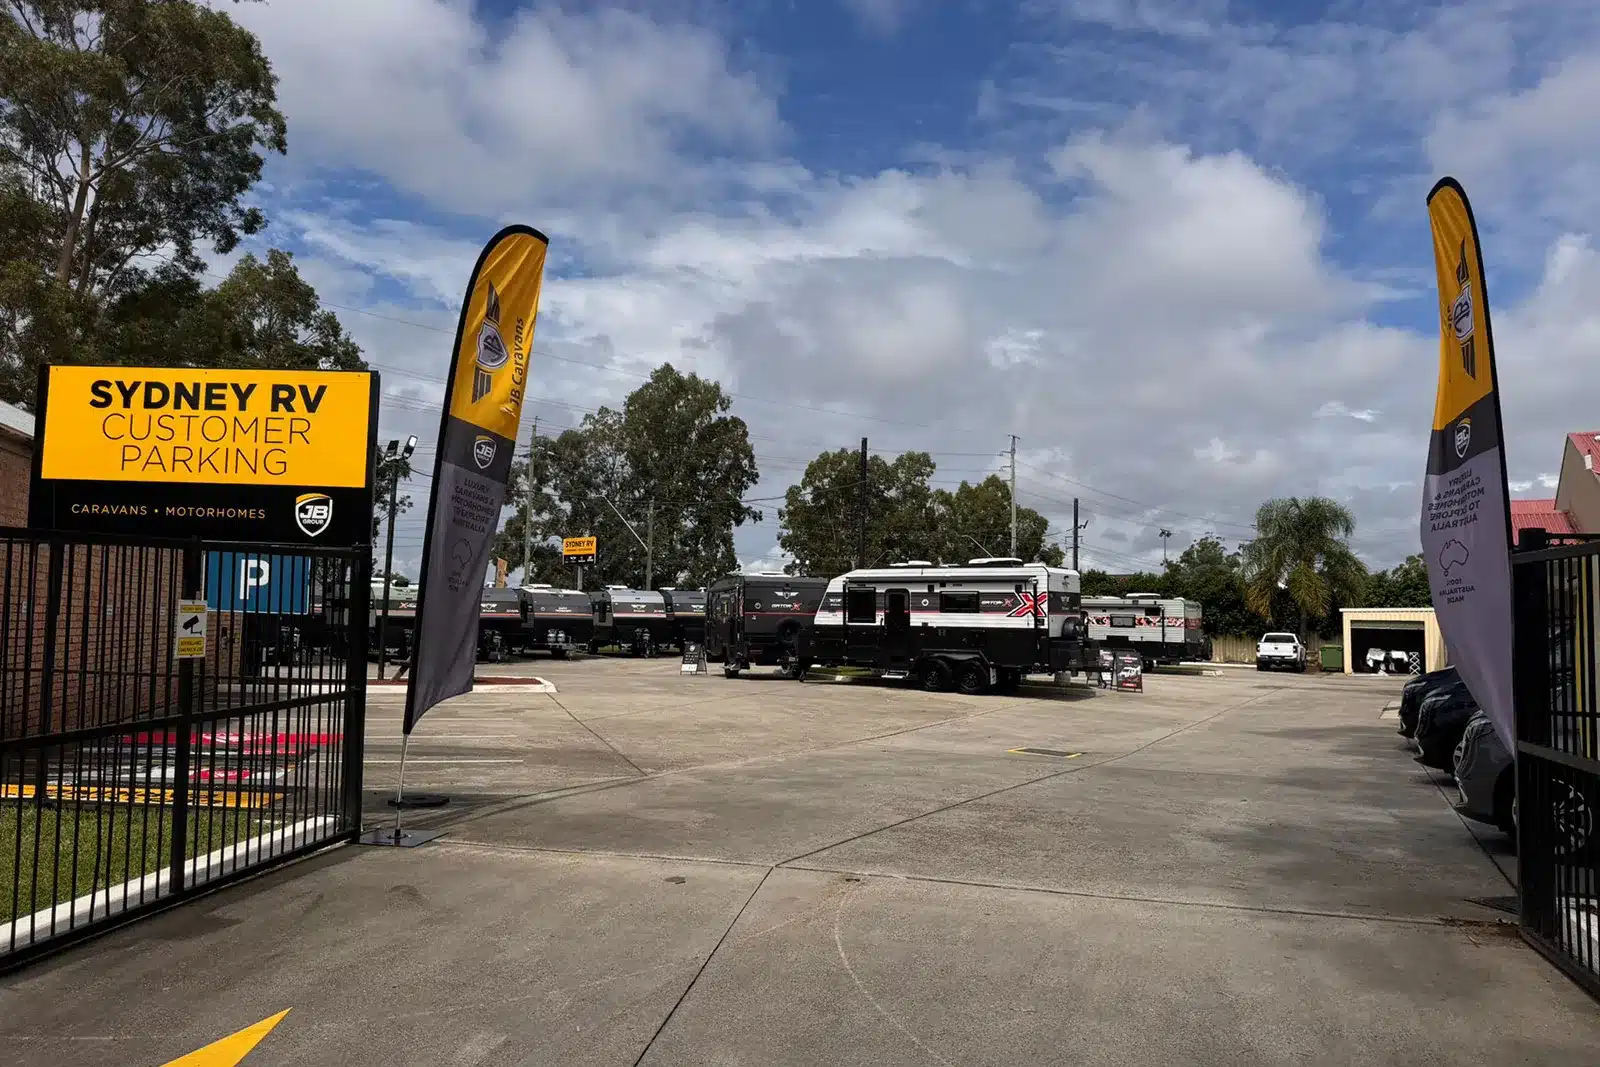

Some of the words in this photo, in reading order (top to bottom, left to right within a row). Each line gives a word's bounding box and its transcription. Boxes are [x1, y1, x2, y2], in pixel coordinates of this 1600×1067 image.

[512, 317, 524, 386] Caravans
[89, 379, 257, 412] SYDNEY
[270, 384, 328, 413] RV
[509, 388, 521, 407] JB
[102, 413, 312, 445] CUSTOMER
[121, 445, 288, 476] PARKING
[476, 444, 493, 458] JB
[71, 503, 148, 516] CARAVANS
[165, 506, 266, 519] MOTORHOMES
[300, 505, 329, 519] JB
[239, 558, 270, 600] P
